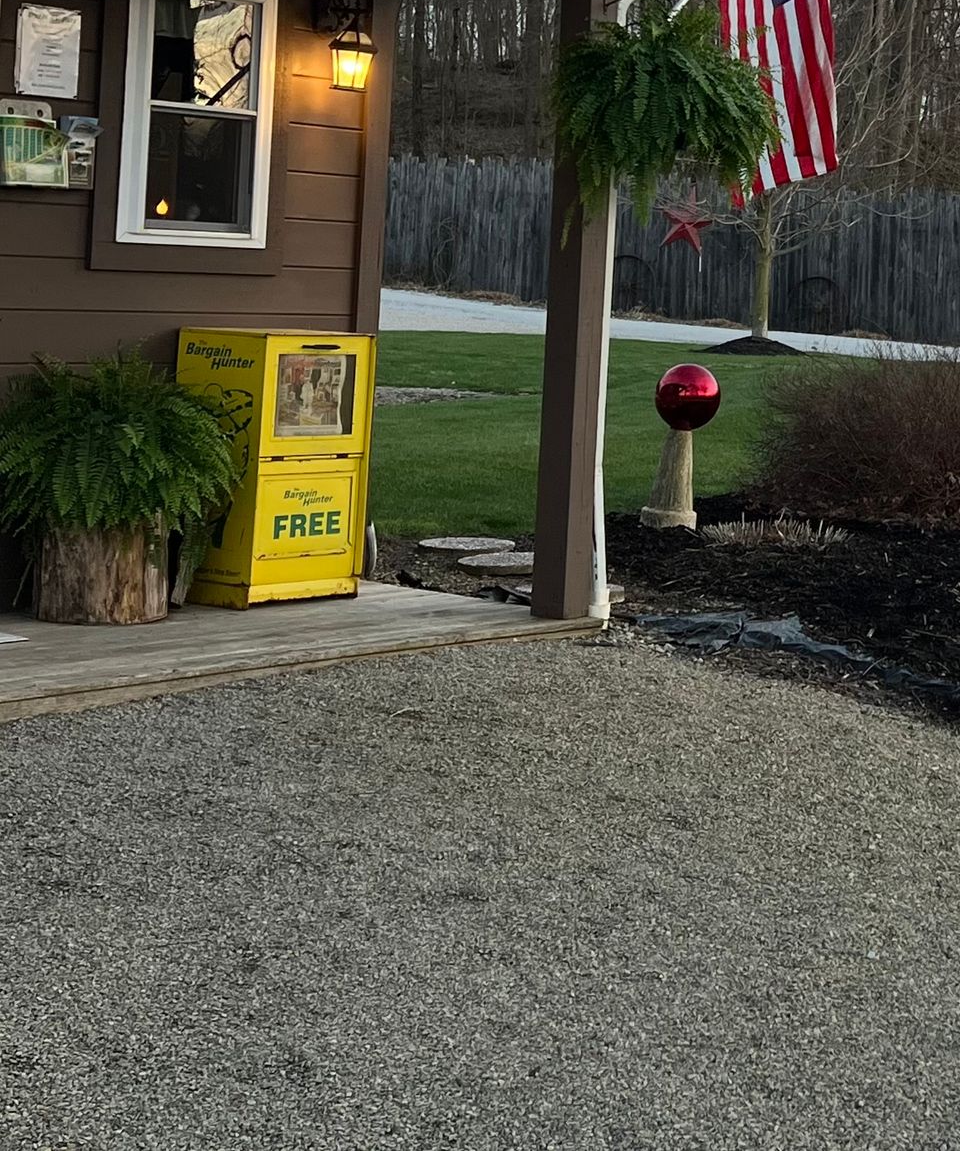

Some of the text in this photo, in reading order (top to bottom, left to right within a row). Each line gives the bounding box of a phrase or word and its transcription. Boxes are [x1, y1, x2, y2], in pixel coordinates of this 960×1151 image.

[186, 342, 232, 358] Bargain
[211, 357, 255, 370] Hunter
[284, 489, 318, 500] Bargain
[302, 495, 333, 506] Hunter
[273, 511, 341, 540] FREE
